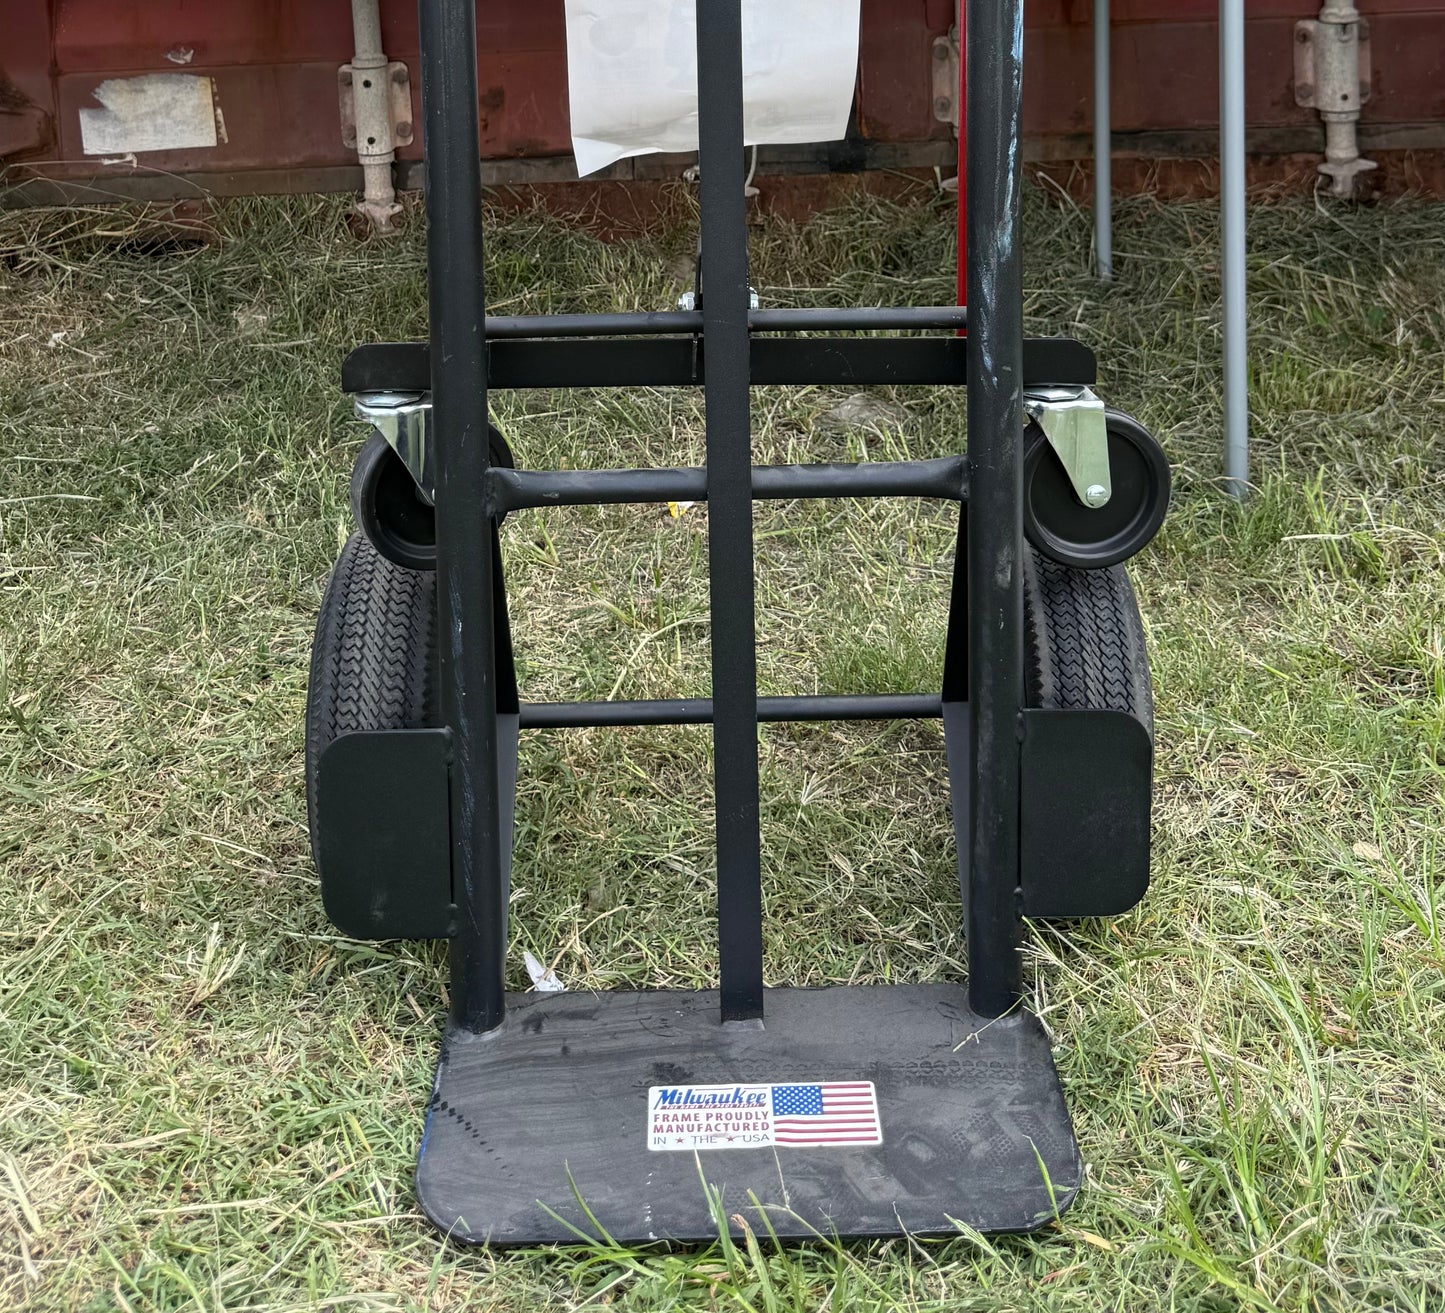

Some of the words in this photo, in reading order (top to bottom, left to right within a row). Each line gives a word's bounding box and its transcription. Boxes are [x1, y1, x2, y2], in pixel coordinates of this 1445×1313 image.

[653, 1087, 767, 1110] Milwaukee
[653, 1112, 700, 1122] FRAME
[705, 1111, 769, 1121] PROUDLY
[653, 1122, 770, 1134] MANUFACTURED
[653, 1137, 667, 1145] IN
[691, 1135, 718, 1144] THE
[742, 1134, 770, 1143] USA
